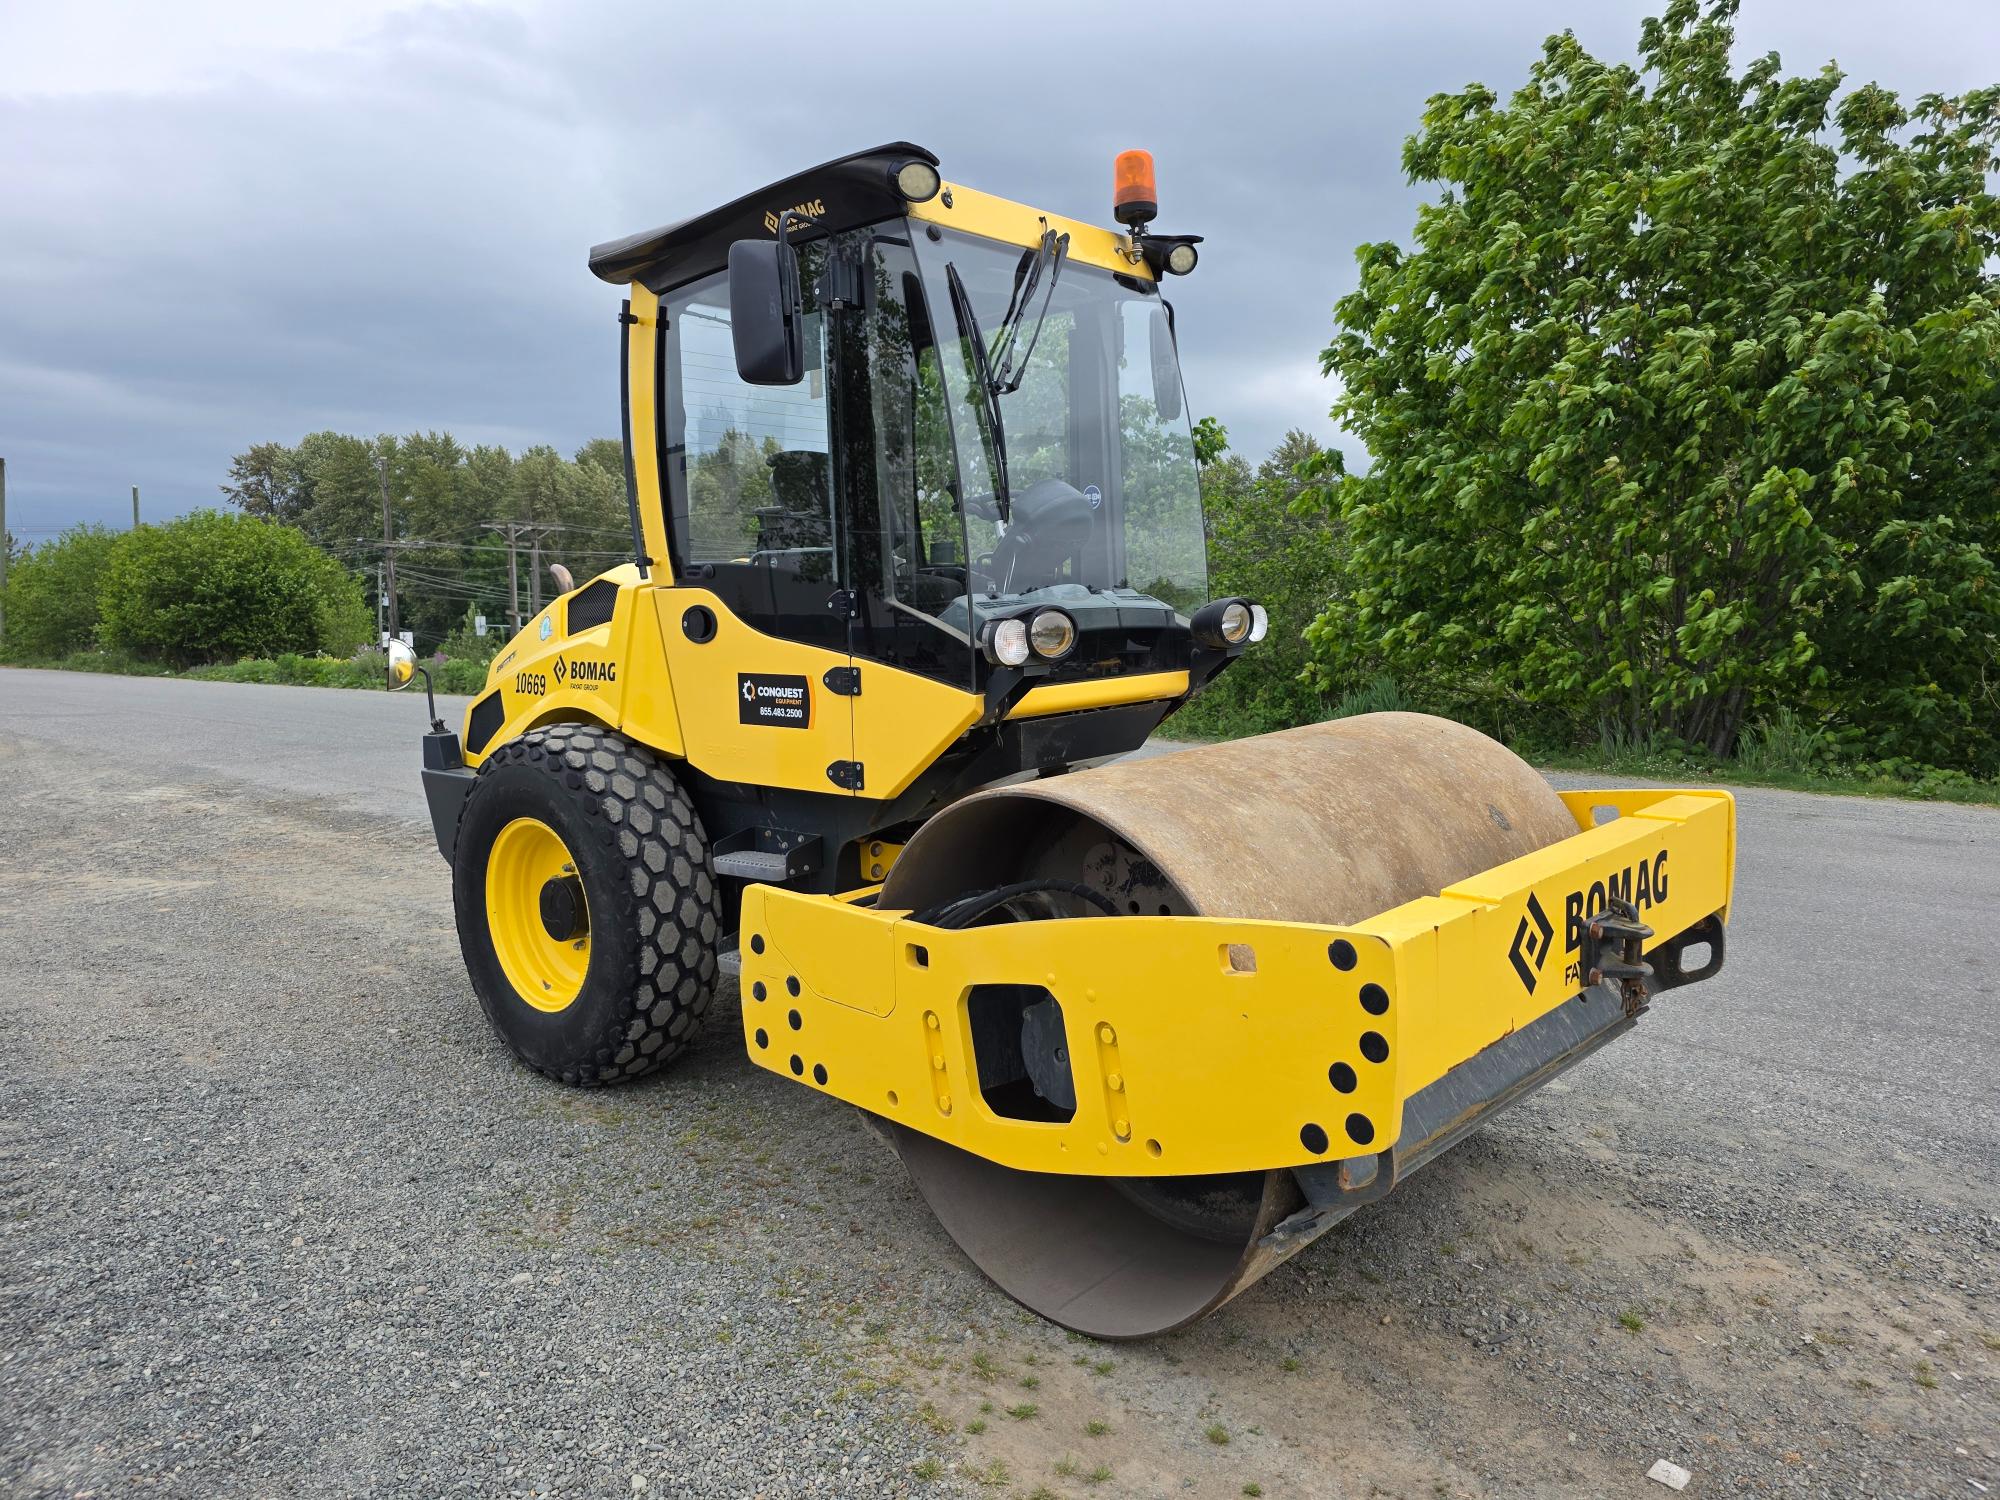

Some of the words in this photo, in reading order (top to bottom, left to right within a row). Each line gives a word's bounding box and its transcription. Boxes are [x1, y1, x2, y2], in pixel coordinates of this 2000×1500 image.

[780, 199, 826, 226] MAG
[570, 661, 616, 681] BOMAG
[516, 673, 545, 696] 10669
[758, 687, 803, 698] CONQUEST
